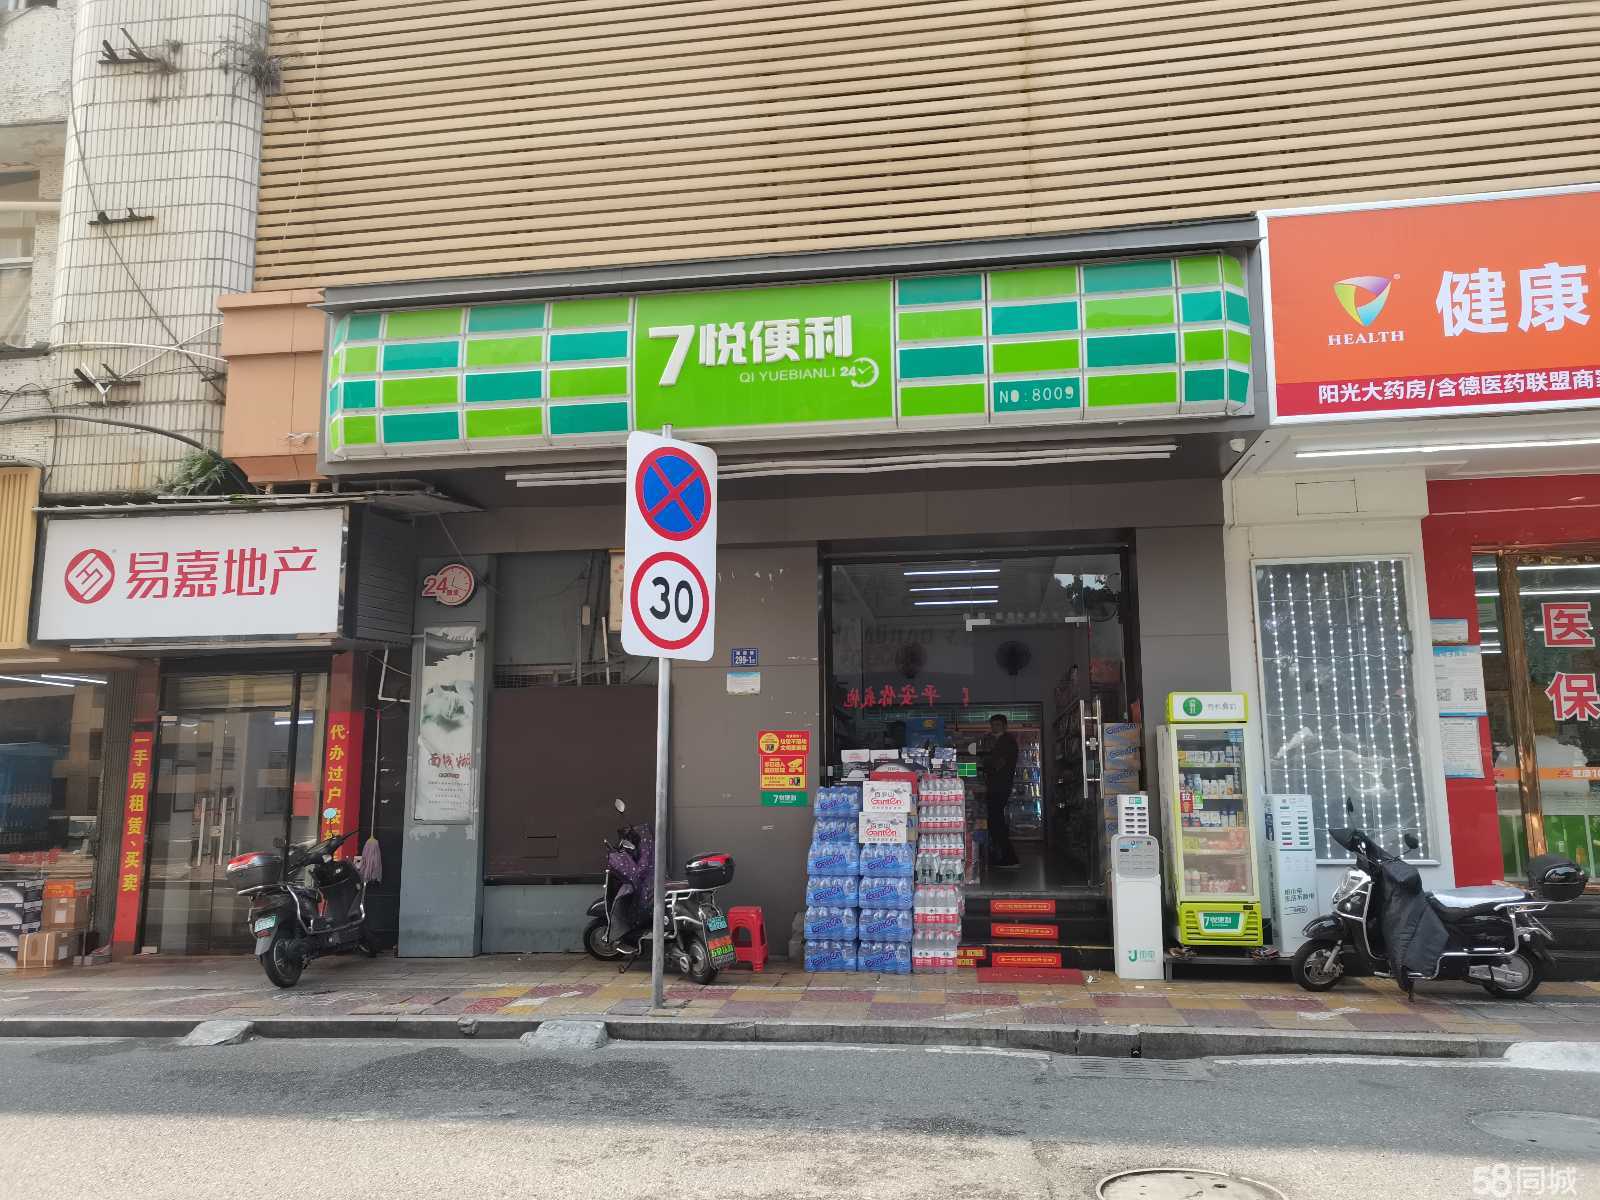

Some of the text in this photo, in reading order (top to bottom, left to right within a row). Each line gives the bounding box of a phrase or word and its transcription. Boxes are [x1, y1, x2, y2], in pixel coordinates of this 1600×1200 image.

[1436, 262, 1591, 336] 健康
[1327, 330, 1406, 346] HEALTH
[739, 372, 755, 384] QI
[760, 367, 836, 382] YUEBIANLI
[126, 545, 318, 599] 易嘉地产
[650, 576, 694, 624] 30
[1541, 601, 1600, 721] 医保
